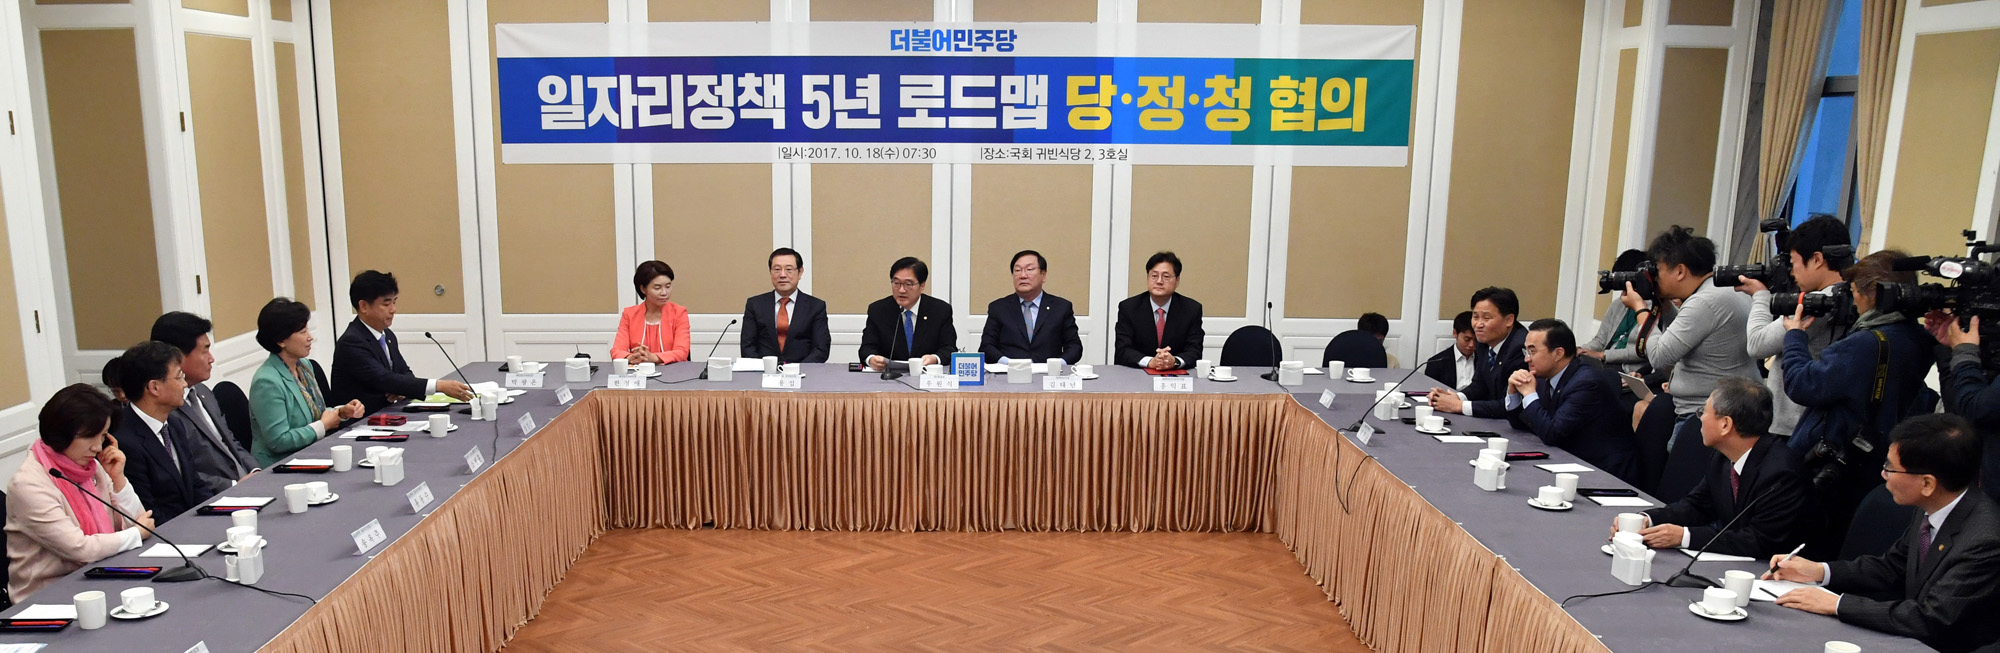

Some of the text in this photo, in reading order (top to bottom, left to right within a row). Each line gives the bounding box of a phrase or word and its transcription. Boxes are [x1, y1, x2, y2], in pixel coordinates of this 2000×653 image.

[890, 28, 1018, 53] 더불어민주당
[537, 72, 786, 130] 일자리정책
[801, 73, 881, 130] 5년
[897, 74, 1048, 130] 로드맵
[1269, 75, 1368, 133] 협의
[902, 147, 937, 160] 07:30
[1036, 147, 1081, 161] 귀빈식당
[1084, 148, 1095, 161] 2,
[1098, 148, 1128, 161] 3호실
[958, 362, 978, 370] 더불어
